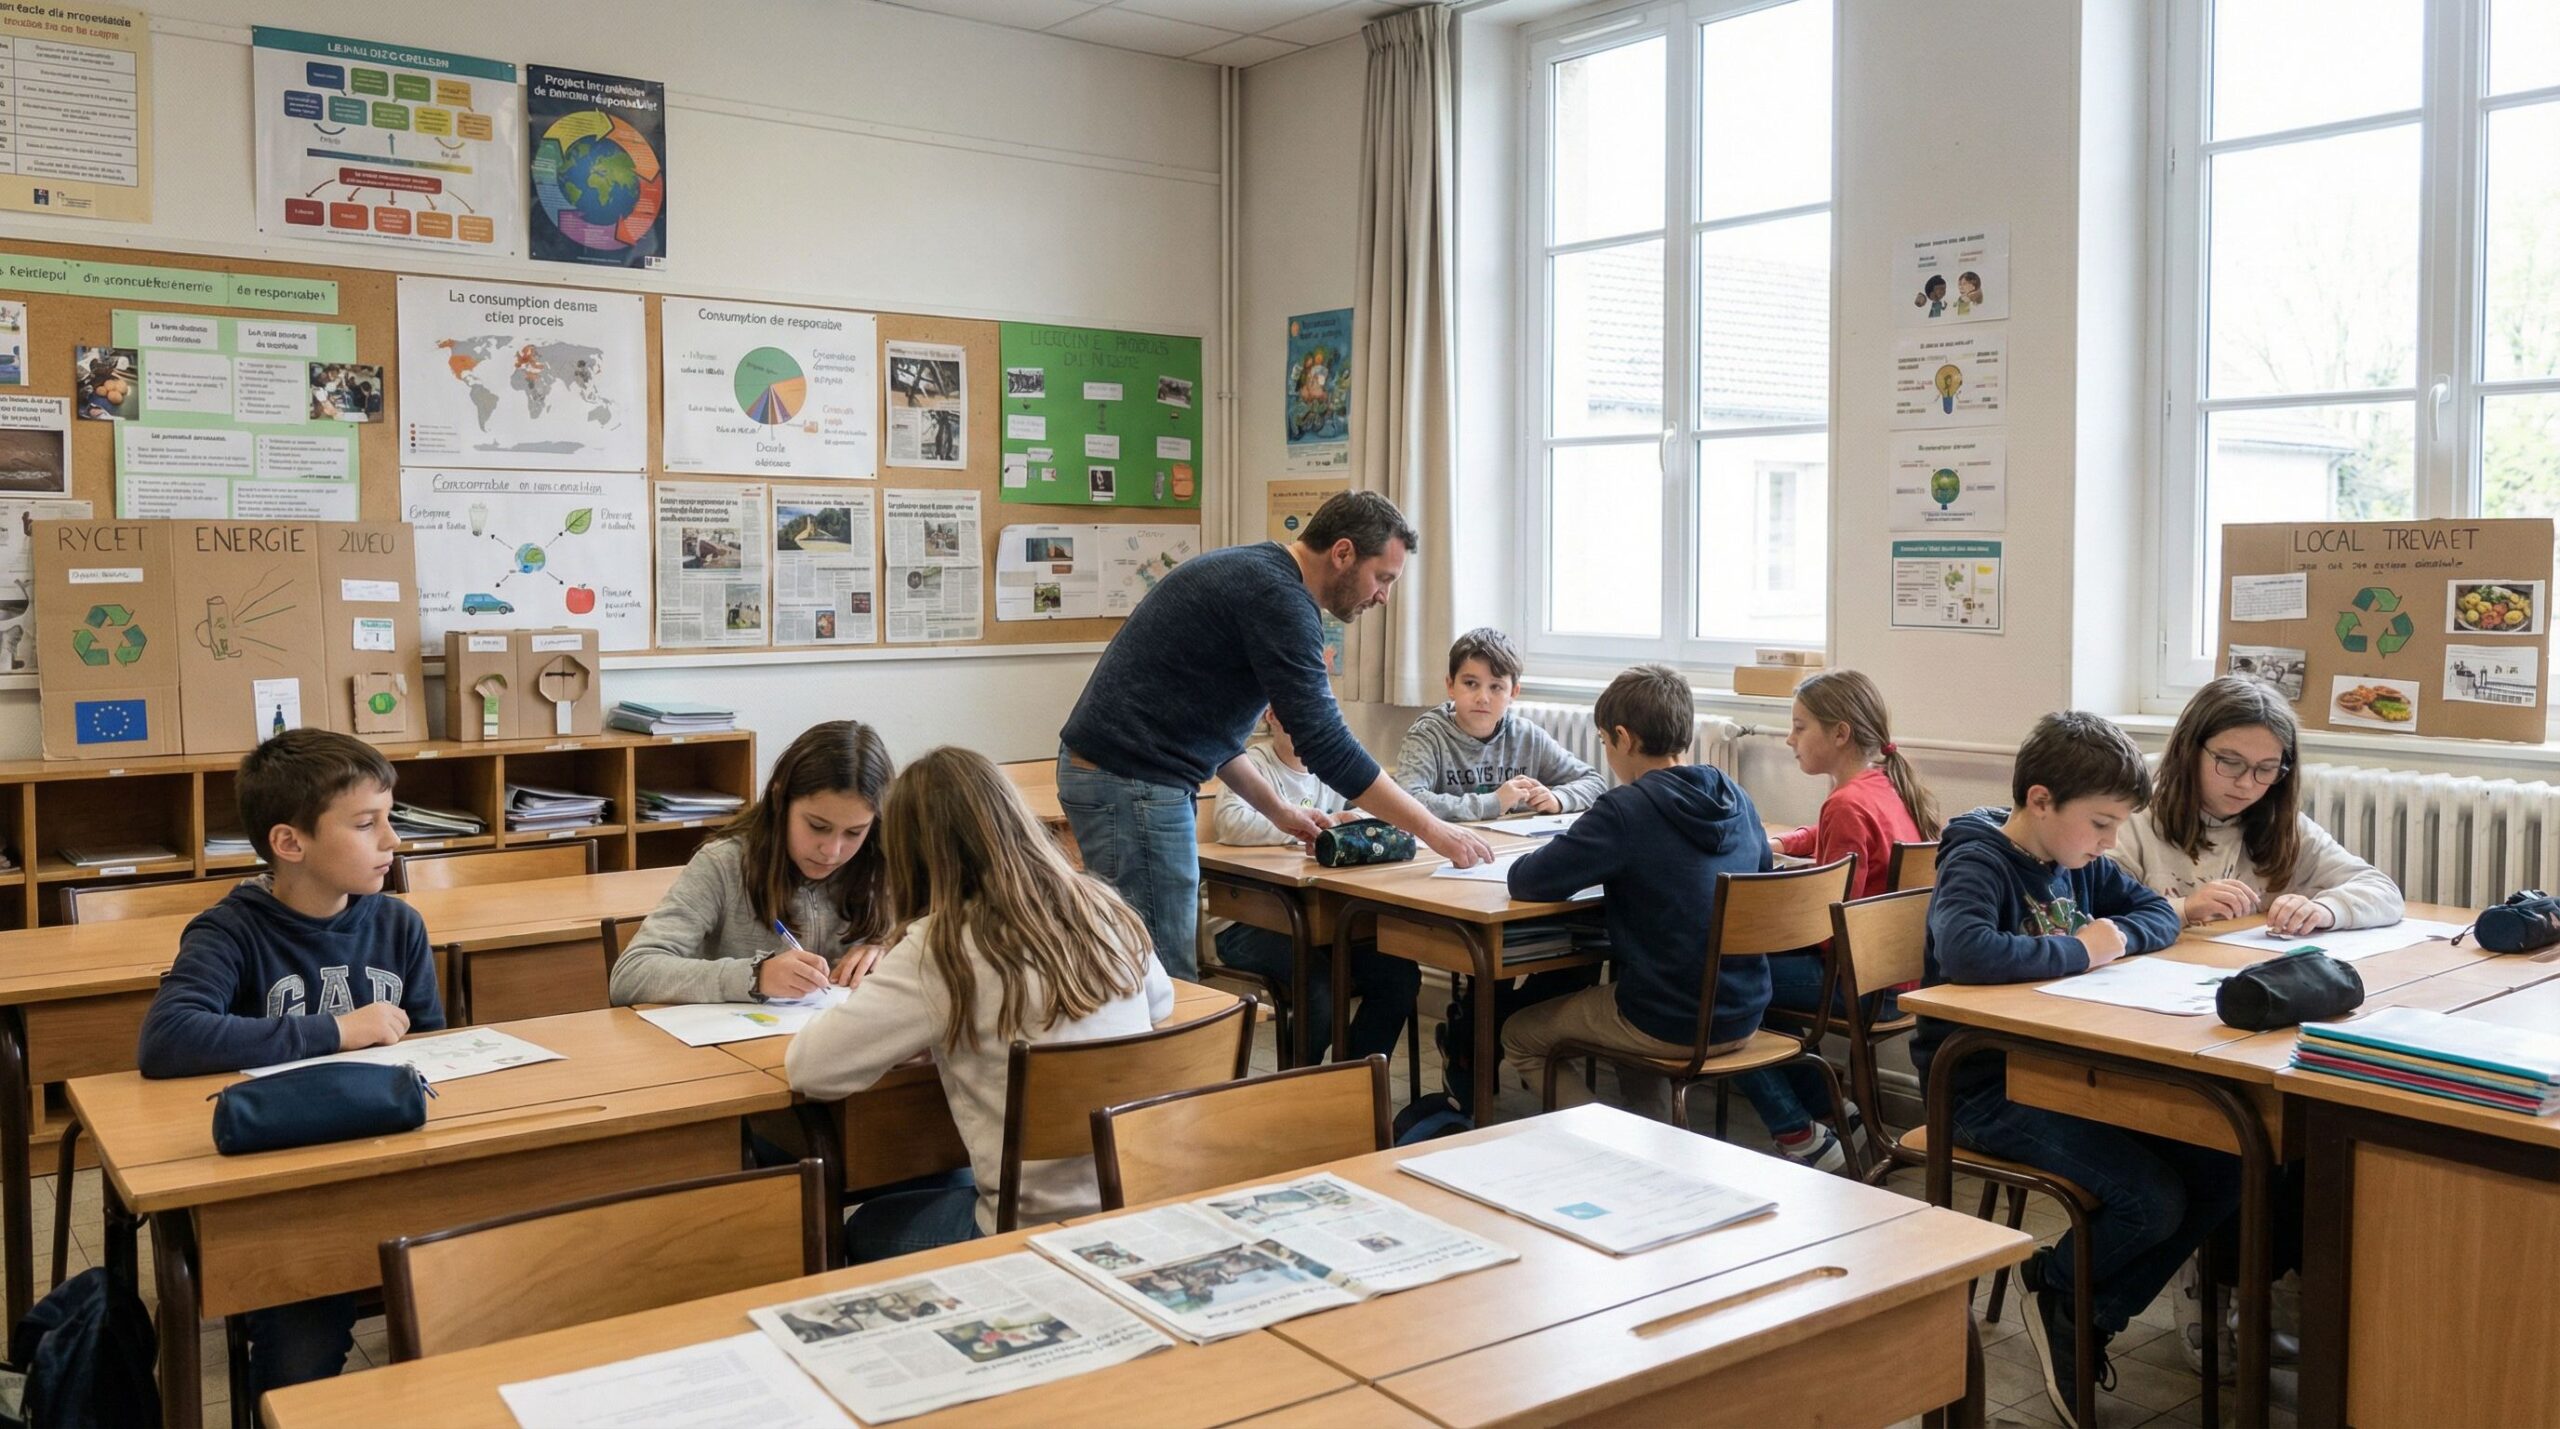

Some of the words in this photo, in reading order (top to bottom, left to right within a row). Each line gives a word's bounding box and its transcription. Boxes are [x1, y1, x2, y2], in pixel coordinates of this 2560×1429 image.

[449, 289, 465, 303] La
[469, 293, 550, 310] consumption
[770, 314, 784, 326] de
[58, 526, 148, 552] RYCET
[2294, 529, 2365, 553] LOCAL
[2383, 528, 2480, 550] TREVAET
